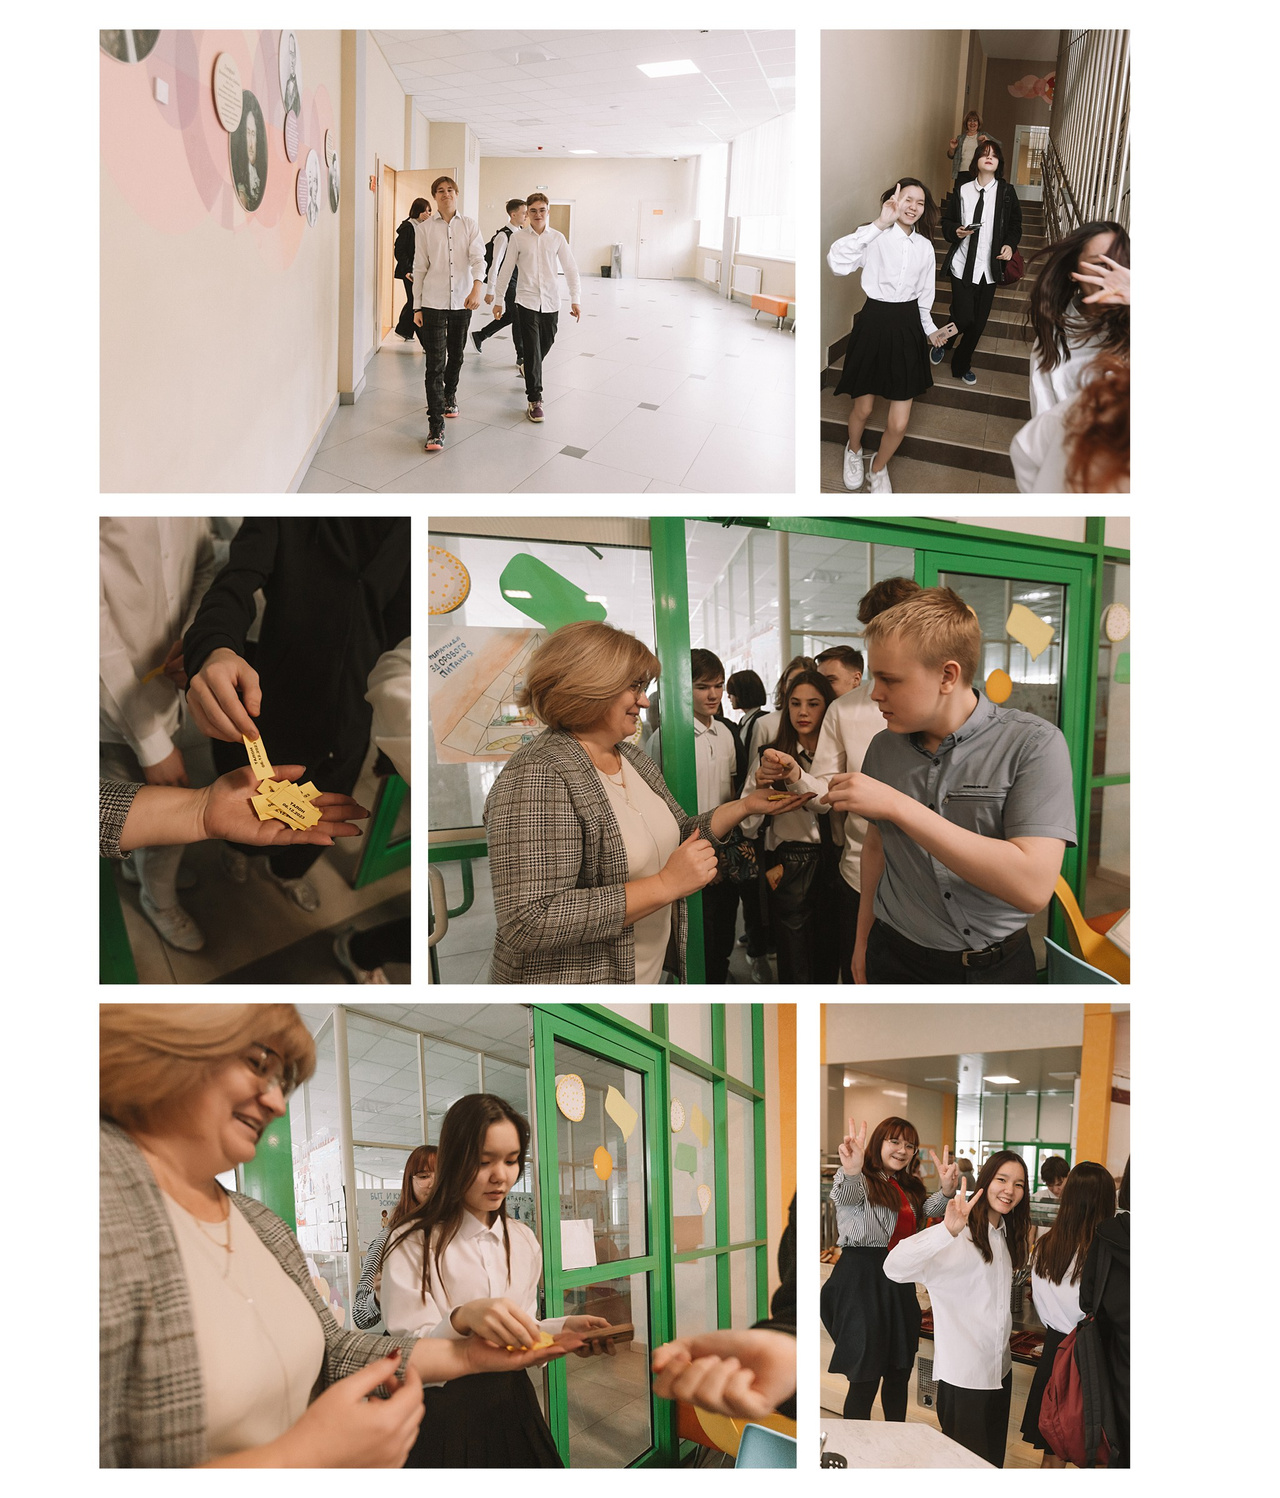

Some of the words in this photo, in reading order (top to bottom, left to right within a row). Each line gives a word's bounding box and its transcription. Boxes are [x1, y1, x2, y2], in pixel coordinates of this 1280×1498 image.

[430, 642, 467, 673] ЗДОРОВОГО
[439, 650, 475, 679] ПИТАНИЯ
[282, 802, 306, 820] 06.12.2023
[289, 801, 306, 814] ТАЛОН
[386, 1192, 392, 1201] И
